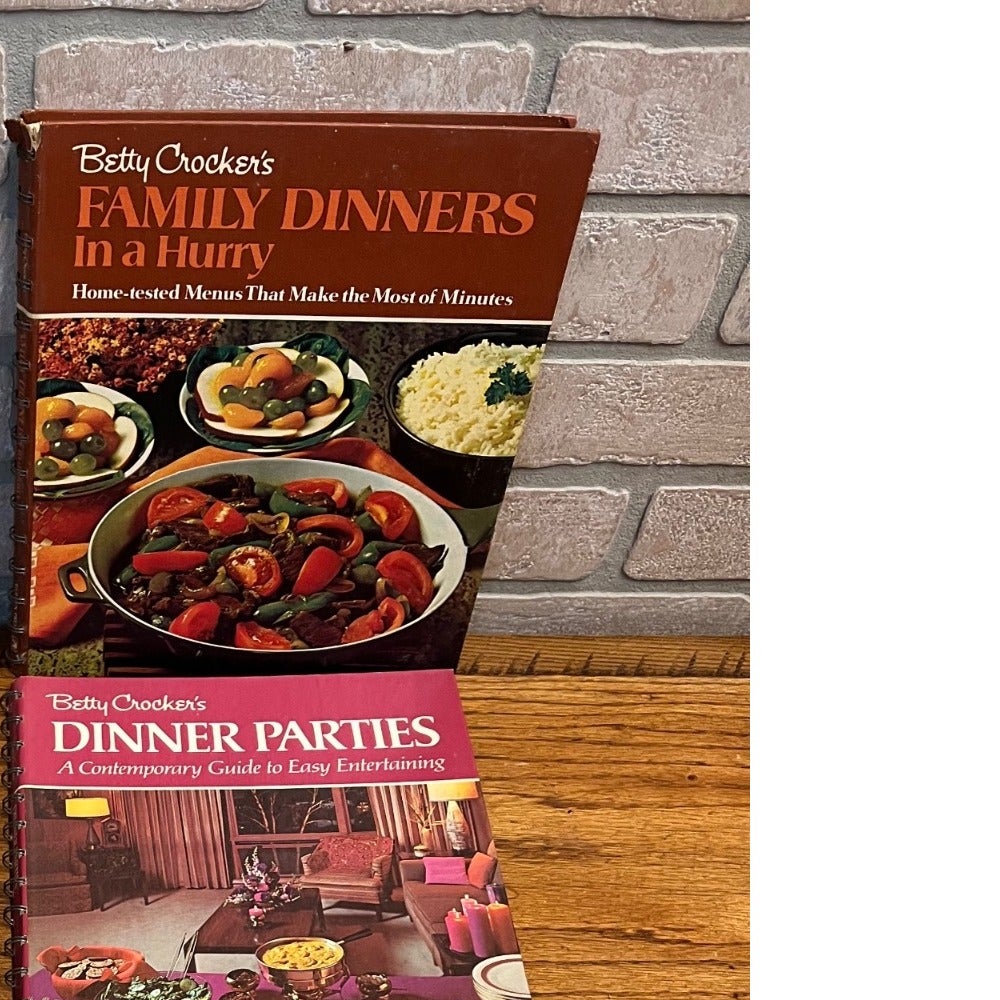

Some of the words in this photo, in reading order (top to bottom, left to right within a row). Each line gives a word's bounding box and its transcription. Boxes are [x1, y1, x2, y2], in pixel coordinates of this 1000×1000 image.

[72, 143, 150, 183] Betty
[155, 142, 275, 175] Crocker's
[77, 186, 271, 230] FAMILY
[280, 188, 537, 236] DINNERS
[74, 235, 113, 267] In
[121, 240, 145, 267] a
[156, 235, 275, 280] Hurry
[72, 283, 180, 300] Home-tested
[184, 284, 243, 301] Menus
[245, 285, 285, 302] That
[288, 286, 339, 303] Make
[342, 287, 370, 303] the
[372, 287, 415, 304] Most
[419, 289, 438, 305] of
[440, 289, 513, 306] Minutes
[45, 693, 108, 716] Betty
[112, 694, 207, 712] Crocker's
[51, 721, 246, 753] DINNER
[253, 715, 441, 752] PARTIES
[57, 760, 74, 775] A
[78, 760, 202, 779] Contemporary
[208, 758, 261, 775] Guide
[267, 759, 283, 774] to
[288, 759, 331, 776] Easy
[337, 755, 446, 773] Entertaining
